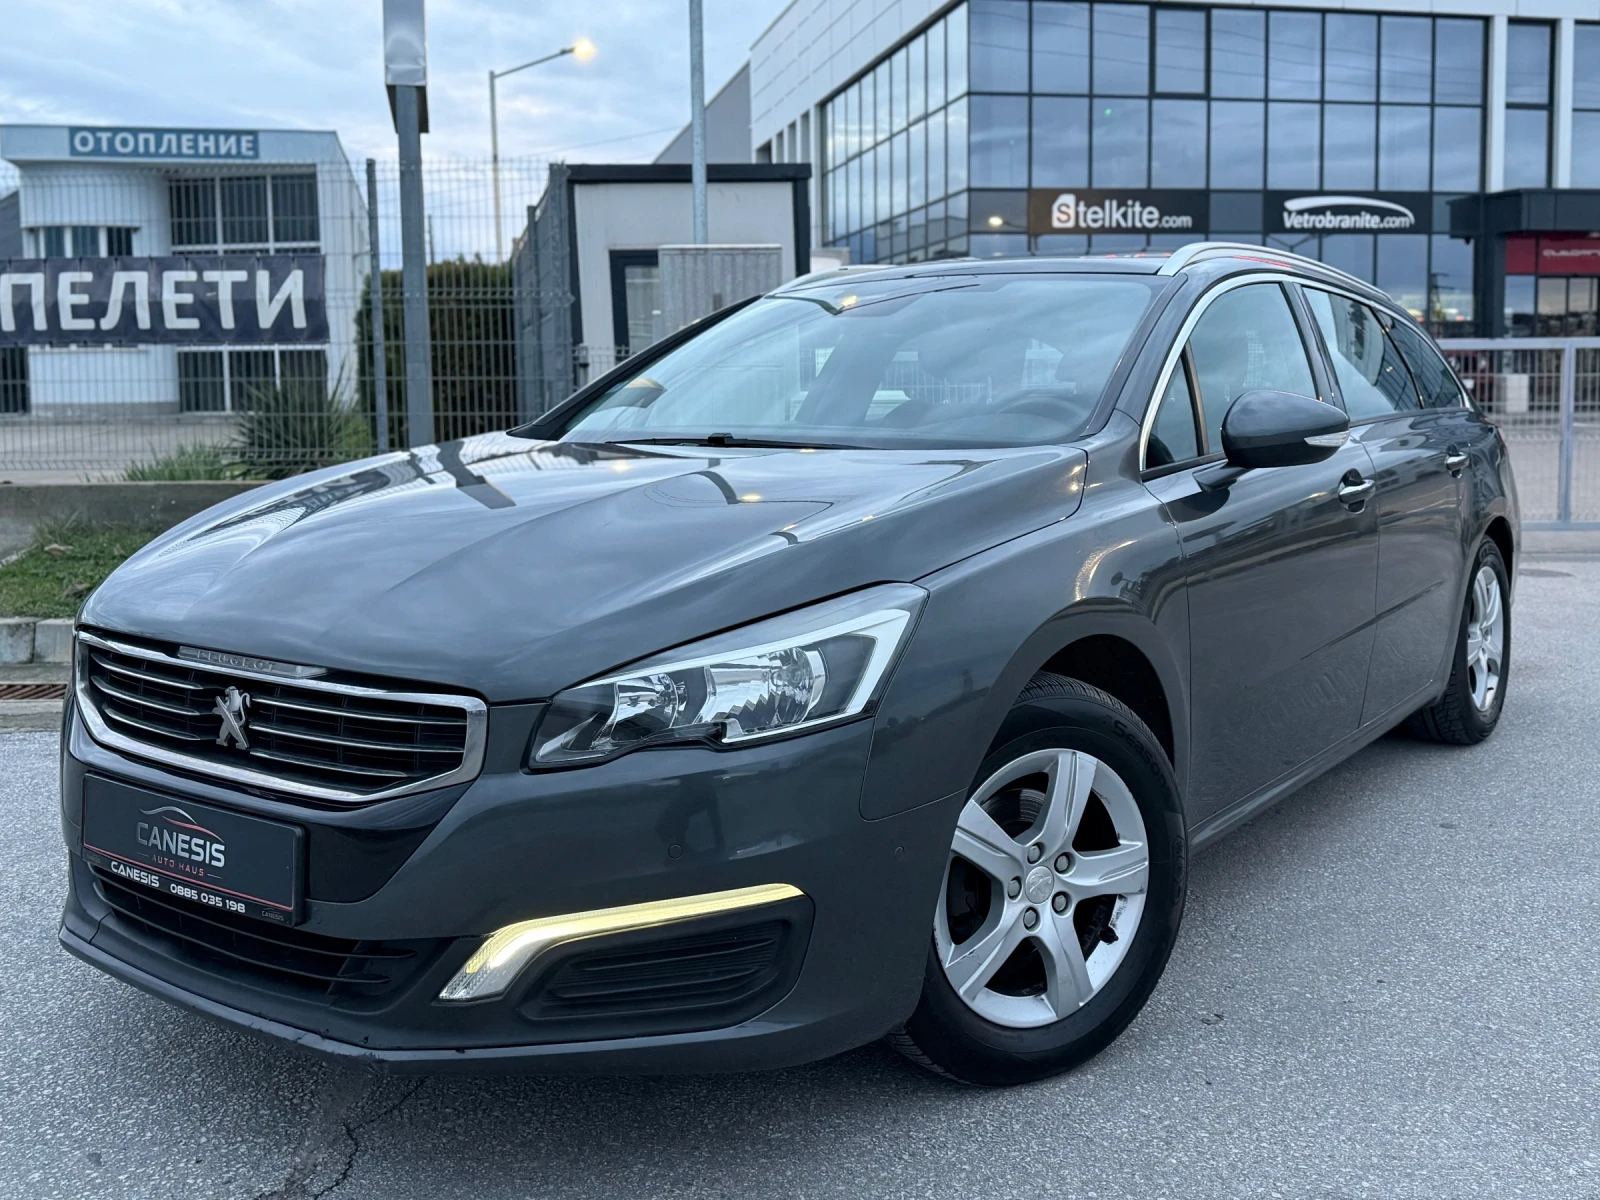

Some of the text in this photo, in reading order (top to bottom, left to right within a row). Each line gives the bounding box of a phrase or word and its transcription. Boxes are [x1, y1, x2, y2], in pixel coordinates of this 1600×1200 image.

[73, 131, 255, 157] ОТОПЛЕНИЕ
[1052, 193, 1192, 228] Stelkite.com
[1283, 210, 1410, 229] Vetrobranite.com
[0, 270, 307, 332] ПЕЛЕТИ
[136, 822, 225, 868] CANESIS
[152, 854, 204, 877] AUTO HAUS
[110, 861, 246, 914] CANESIS 0885 035 198
